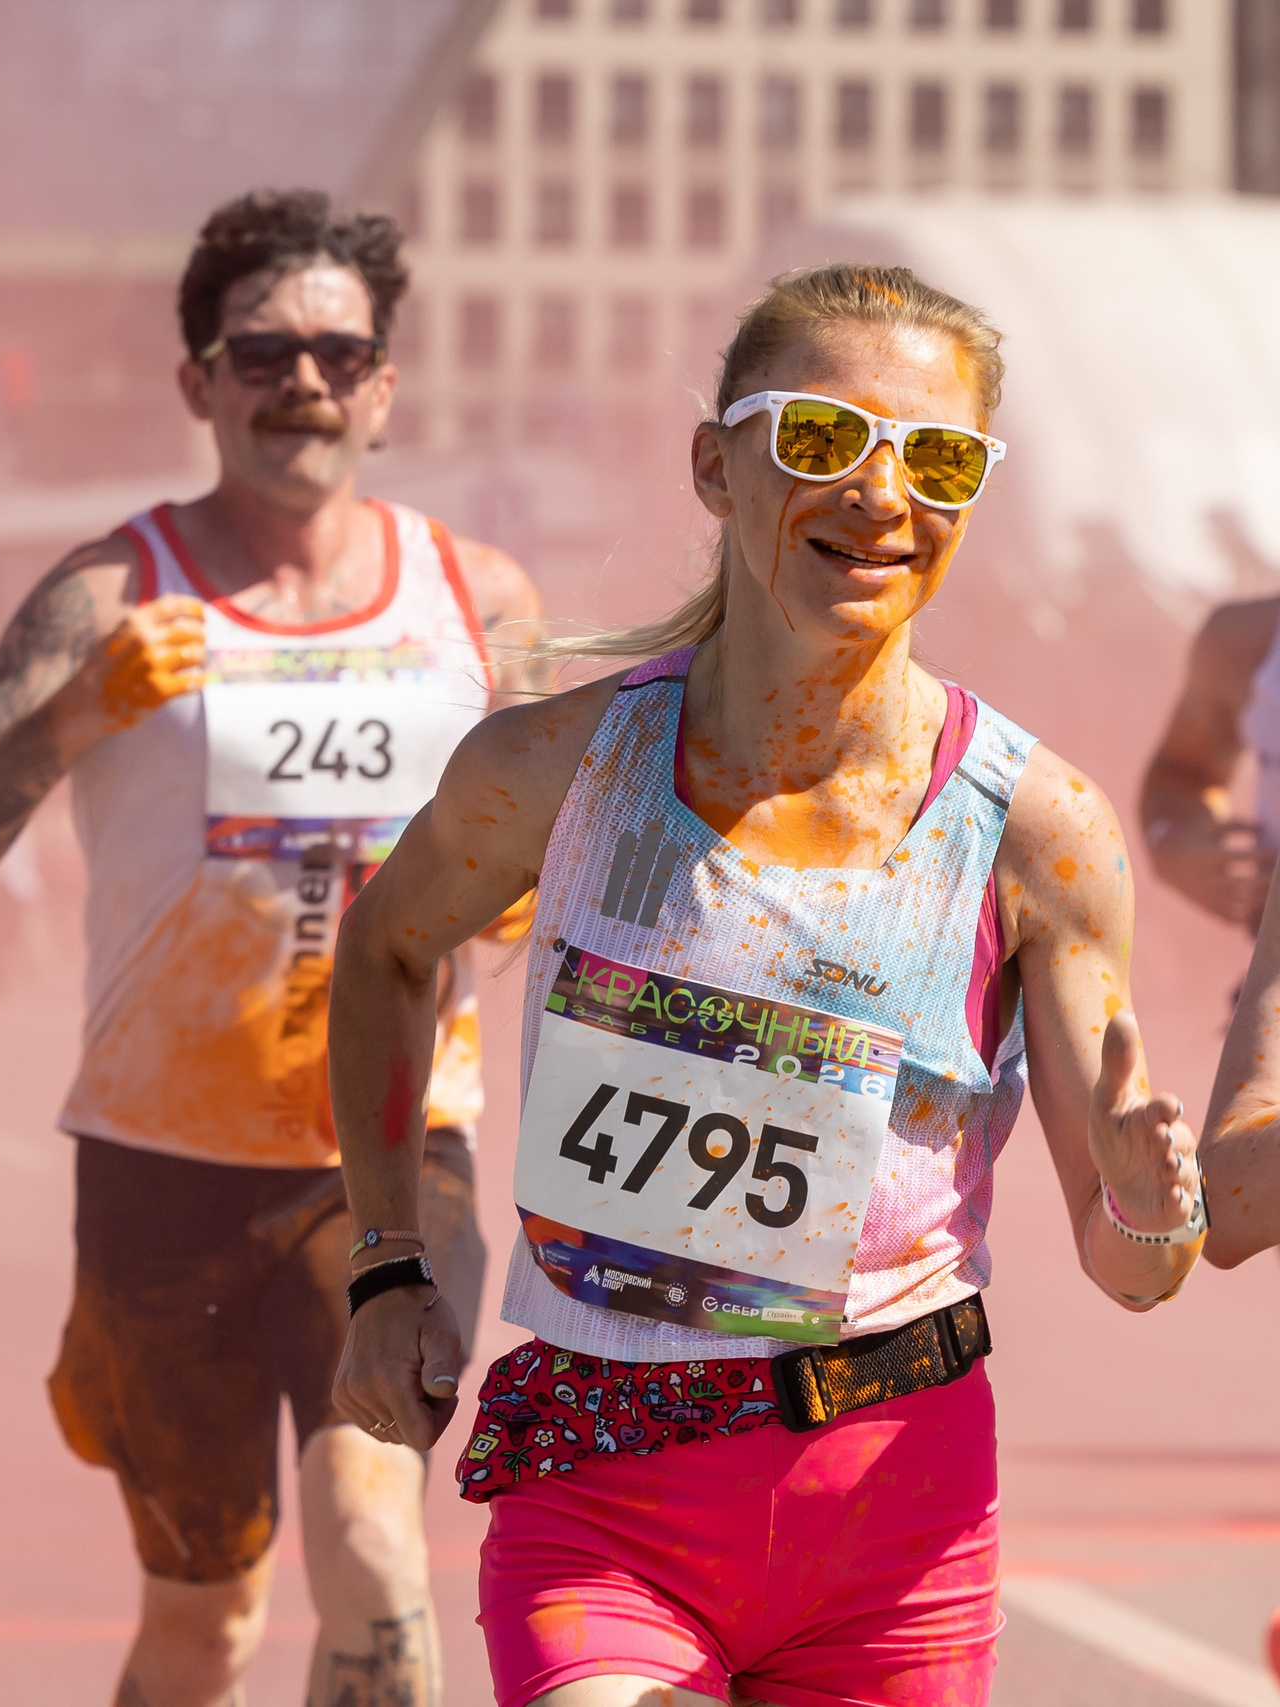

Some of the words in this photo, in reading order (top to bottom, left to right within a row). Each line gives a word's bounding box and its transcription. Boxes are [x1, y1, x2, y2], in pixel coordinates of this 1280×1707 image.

[267, 718, 394, 781] 243
[571, 1004, 716, 1050] ЗАБЕГ
[575, 960, 871, 1068] КРАСОЧНЫЙ
[732, 1044, 888, 1100] 2026
[558, 1082, 820, 1229] 4795
[601, 1278, 625, 1293] СПОРТ
[603, 1268, 652, 1290] МОСКОВСКИЙ
[721, 1302, 760, 1317] СБЕР
